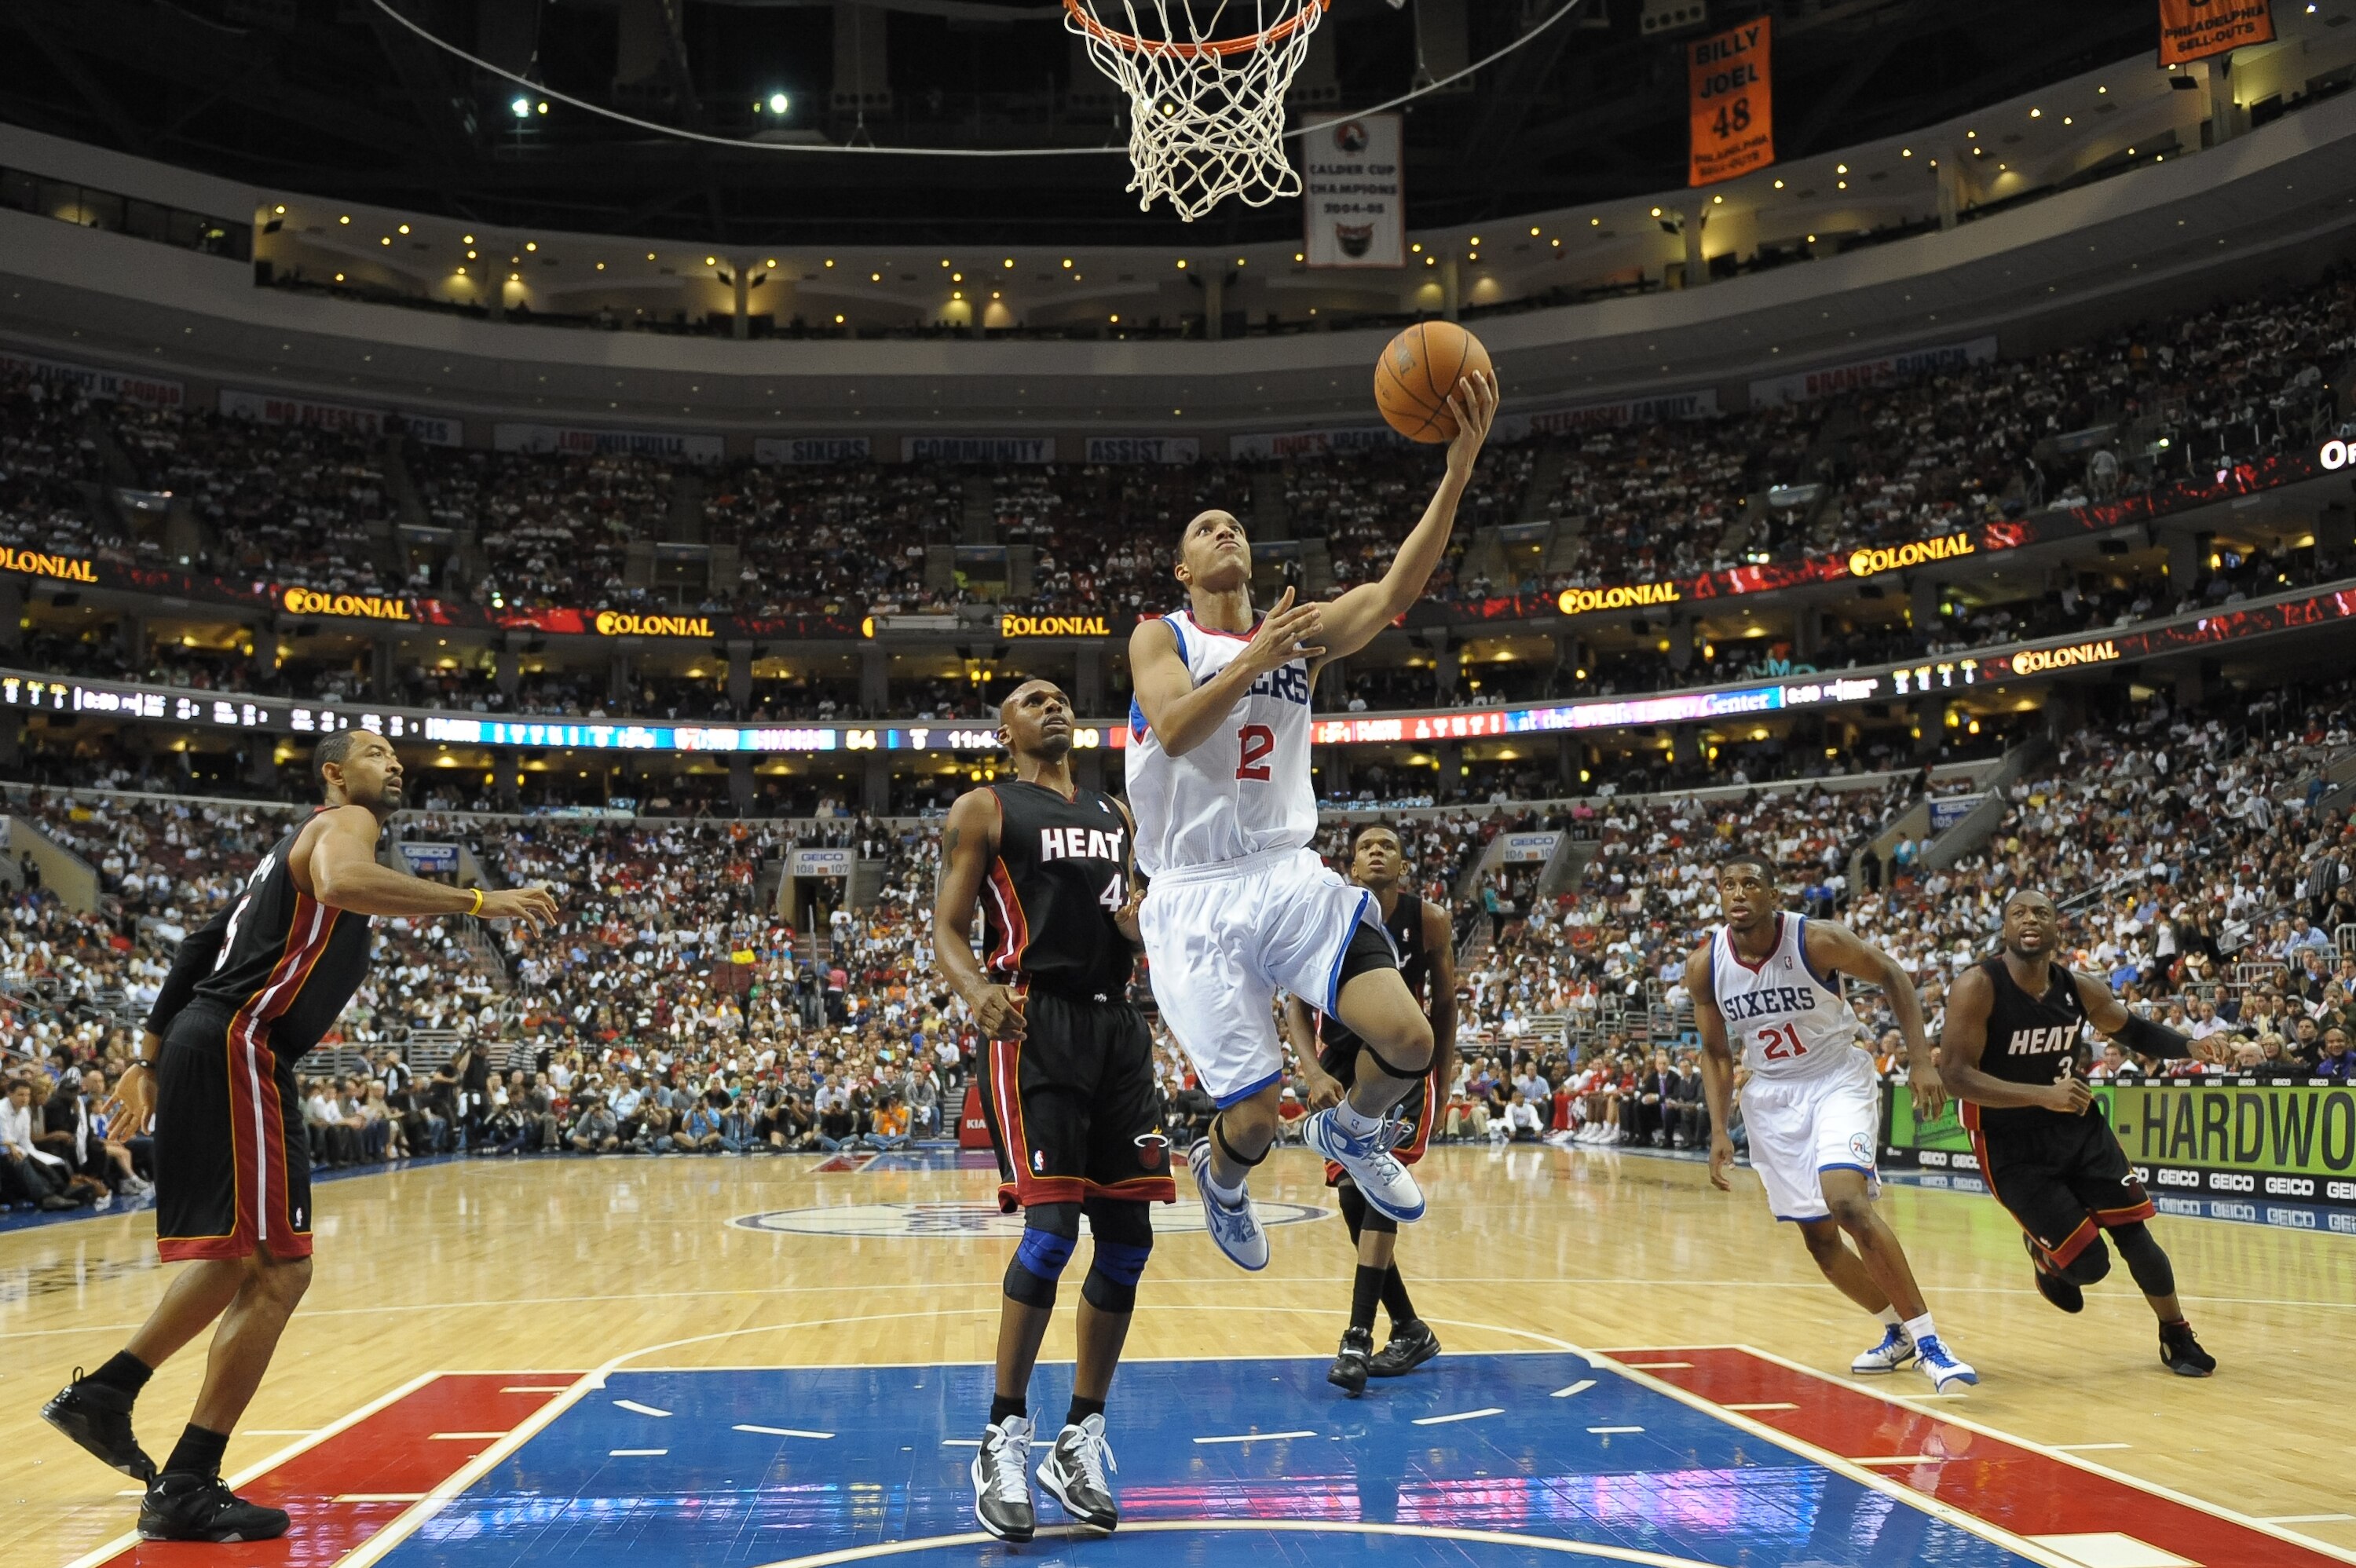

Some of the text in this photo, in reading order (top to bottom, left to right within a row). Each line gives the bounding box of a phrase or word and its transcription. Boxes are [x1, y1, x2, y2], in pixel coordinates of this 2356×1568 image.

[2165, 5, 2264, 38] PHILADELPHIA
[1696, 26, 1760, 64] BILLY
[1700, 63, 1759, 98] JOEL
[1713, 97, 1750, 138] 48
[1309, 164, 1396, 175] CALDER CUP
[1311, 183, 1397, 195] CHAMPIONS
[792, 440, 865, 462] SIXERS
[913, 438, 1044, 461] COMMUNITY
[1090, 439, 1165, 462] ASSIST
[1849, 533, 1974, 577] COLONIAL
[284, 587, 411, 620] COLONIAL
[1559, 582, 1681, 615] COLONIAL
[596, 611, 715, 638] COLONIAL
[2012, 641, 2120, 675] COLONIAL
[1700, 693, 1769, 718] Center
[846, 729, 877, 750] 54
[1040, 826, 1125, 863] HEAT
[1510, 835, 1553, 847] GEICO
[801, 853, 844, 862] GEICO
[831, 864, 849, 874] 107
[1723, 985, 1816, 1022] SIXERS
[1757, 1022, 1809, 1061] 21
[2007, 1014, 2082, 1055] HEAT
[2054, 1055, 2073, 1084] 3
[966, 1119, 987, 1129] KIA
[2157, 1168, 2200, 1187] GEICO
[2209, 1172, 2255, 1192] GEICO
[2266, 1176, 2314, 1197] GEICO
